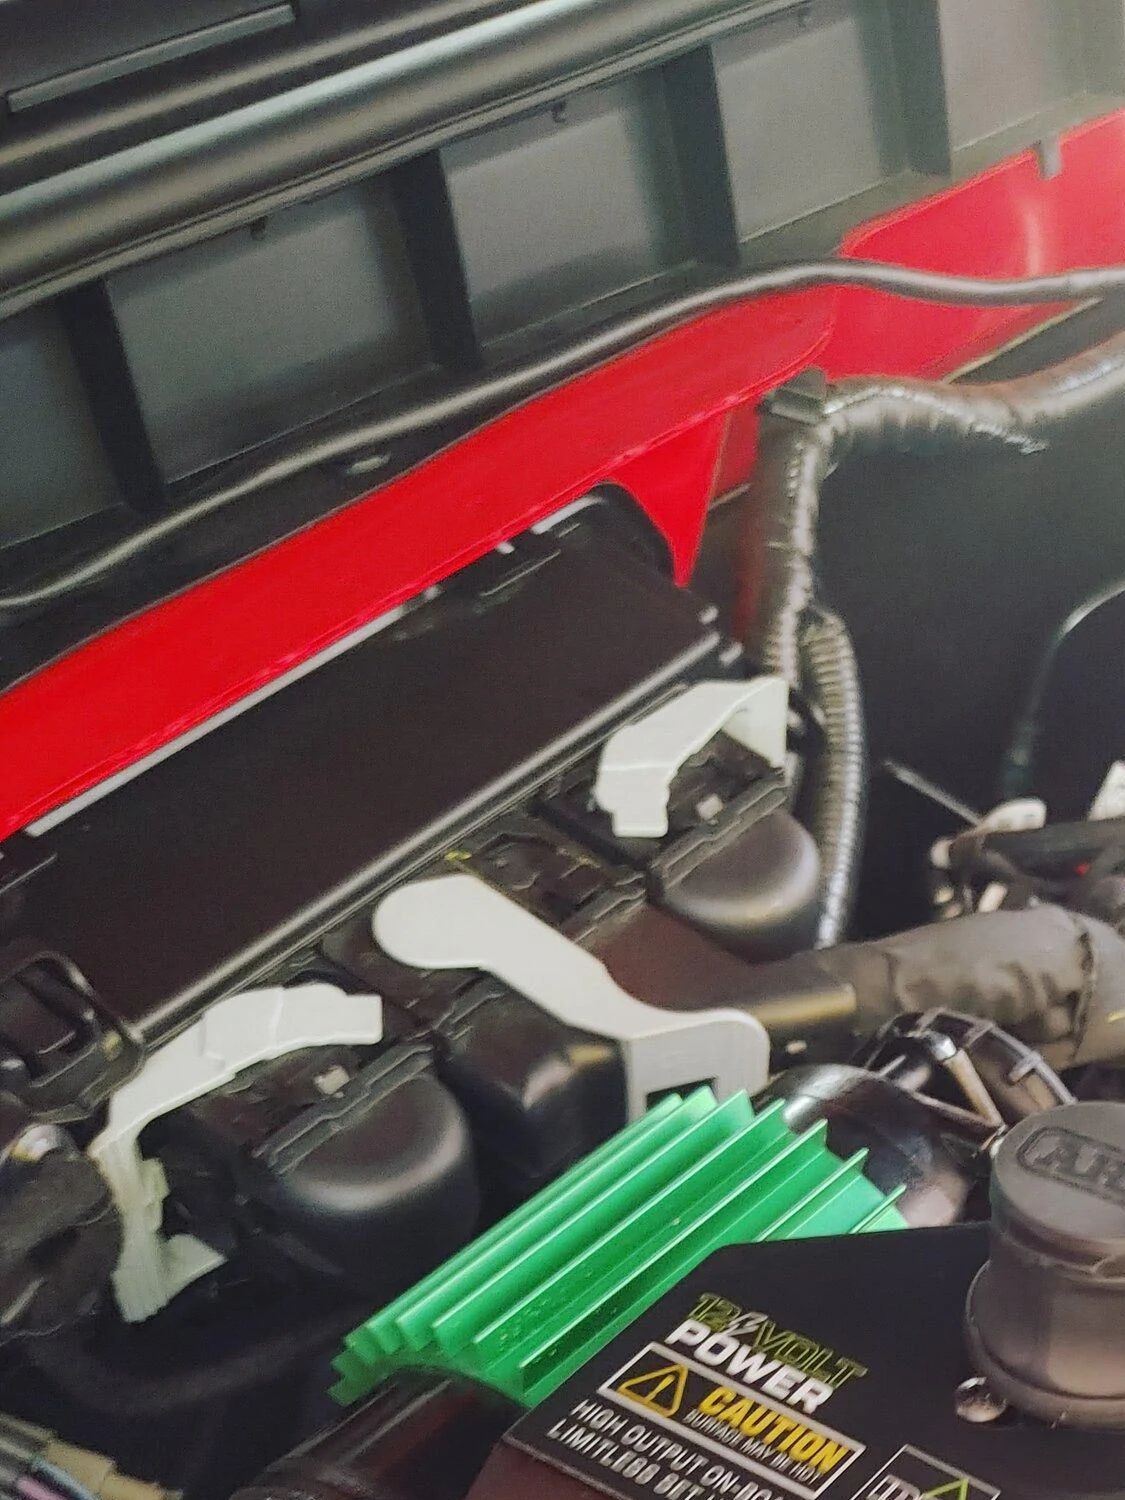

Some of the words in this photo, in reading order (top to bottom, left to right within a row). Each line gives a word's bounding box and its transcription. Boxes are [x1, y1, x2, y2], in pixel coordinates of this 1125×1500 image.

[664, 1318, 834, 1414] POWER
[547, 1418, 661, 1486] LIMITLESS
[570, 1399, 630, 1438] HIGH
[621, 1424, 710, 1477] OUTPUT
[698, 1386, 849, 1474] CAUTION
